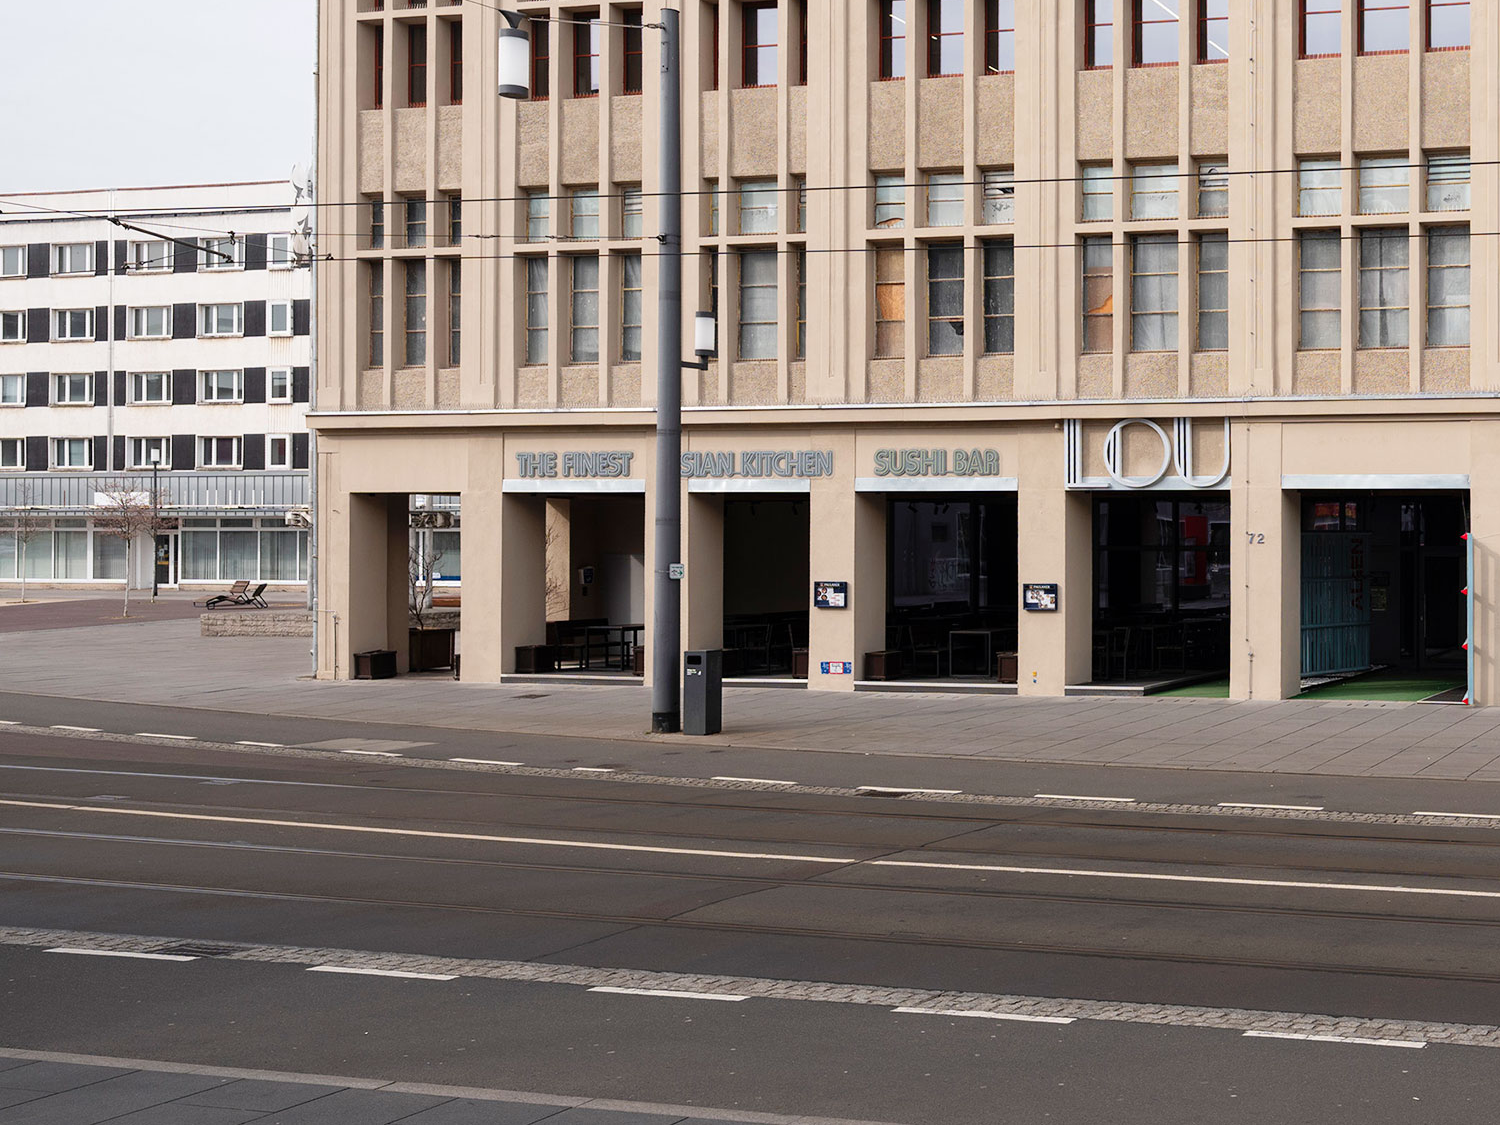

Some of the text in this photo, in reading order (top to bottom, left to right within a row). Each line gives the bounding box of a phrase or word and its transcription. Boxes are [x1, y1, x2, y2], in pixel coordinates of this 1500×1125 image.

[516, 449, 999, 477] THE FINEST SIAN KITCHEN SUSHI BAR
[1064, 417, 1231, 489] LOU
[1248, 534, 1265, 544] 72
